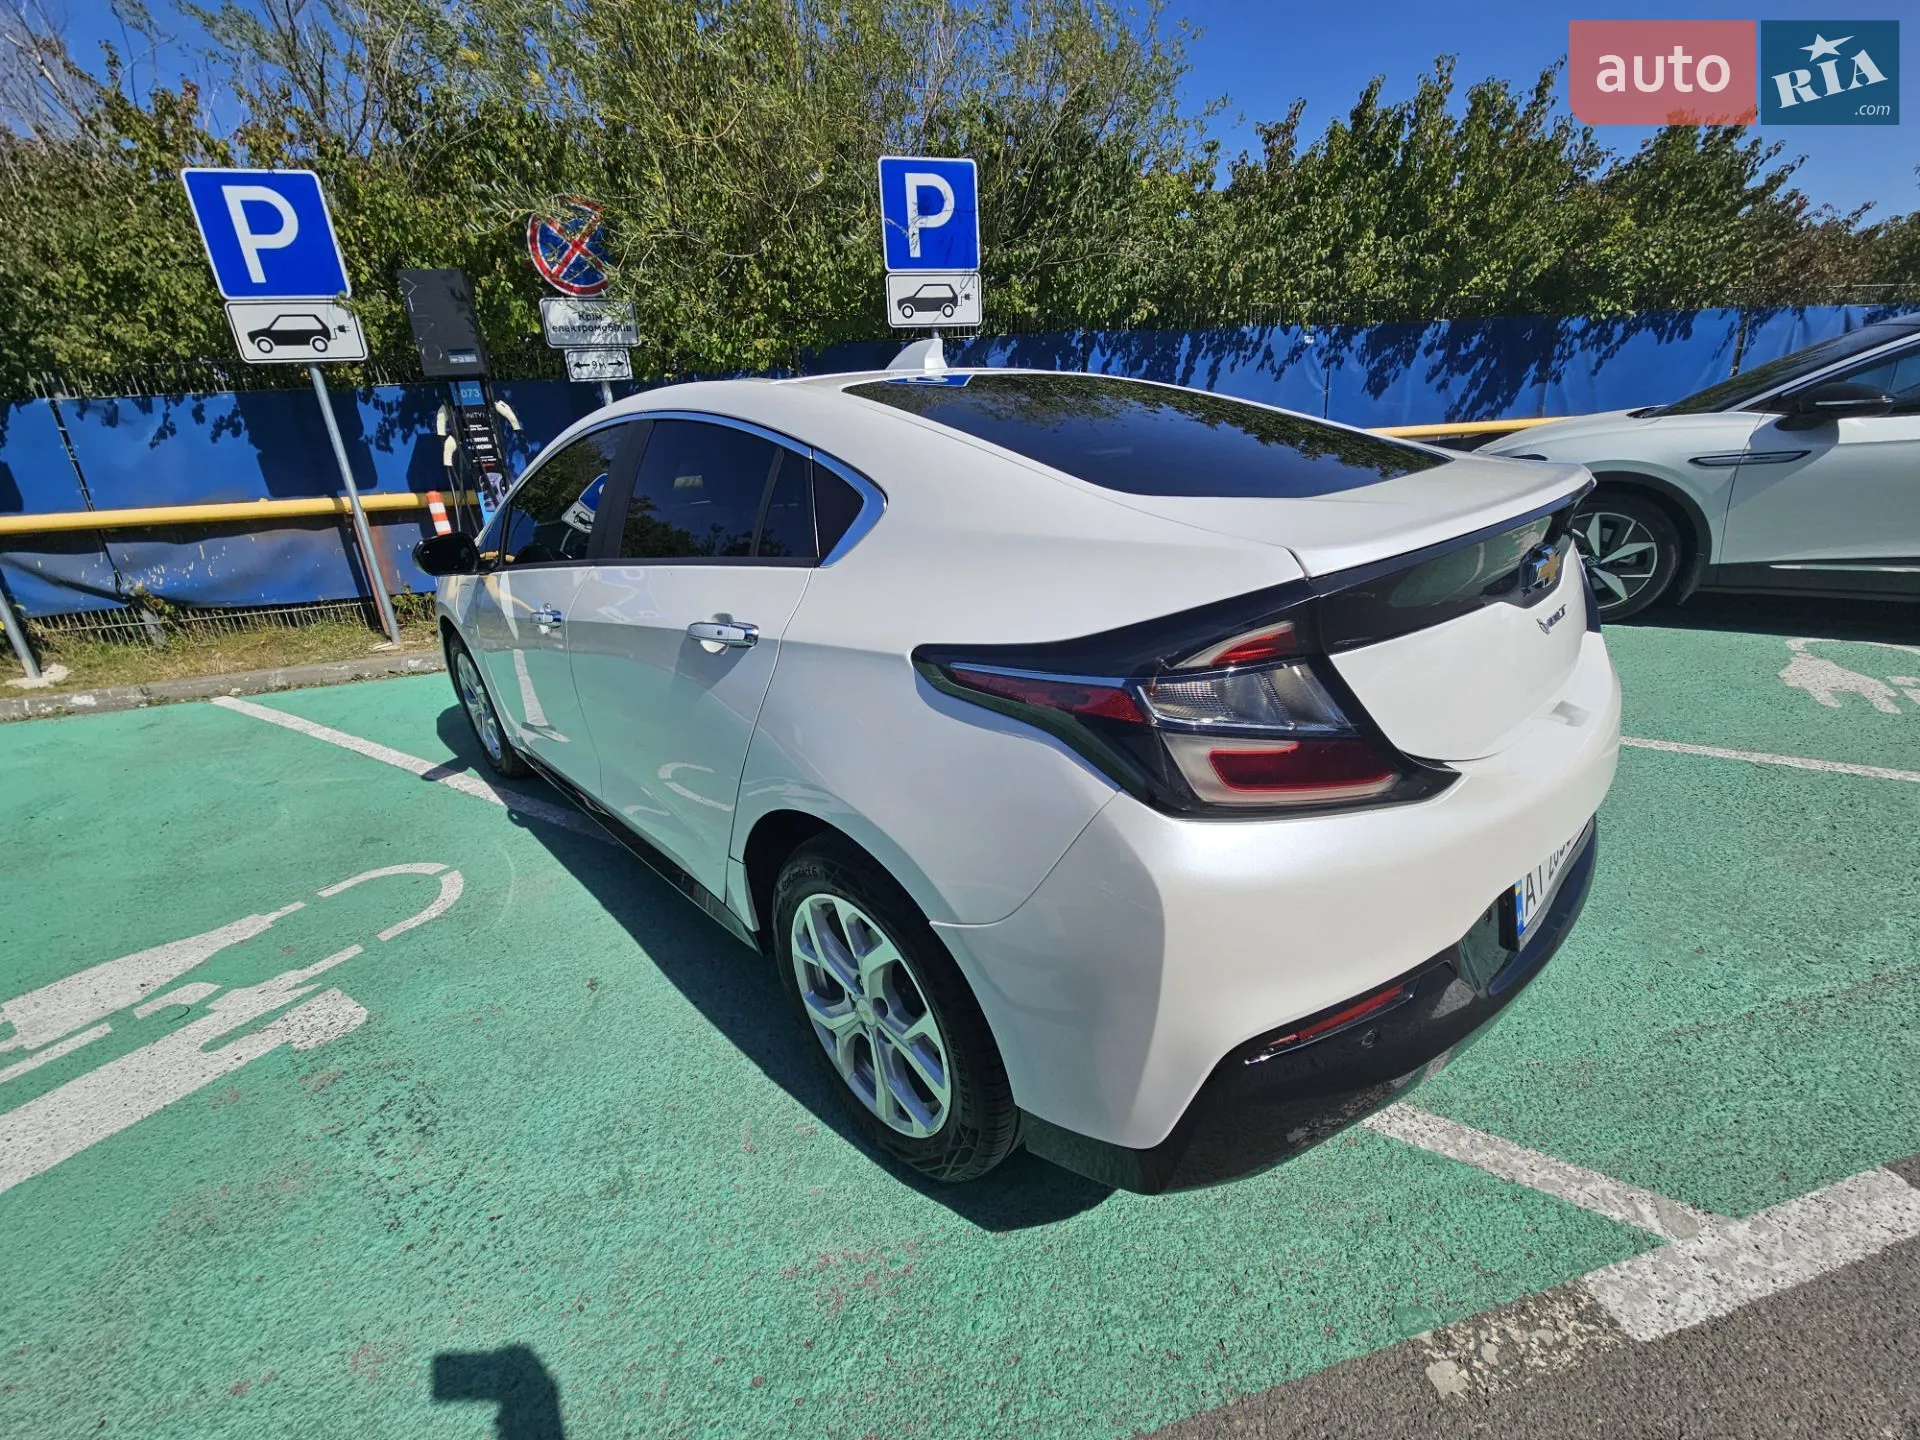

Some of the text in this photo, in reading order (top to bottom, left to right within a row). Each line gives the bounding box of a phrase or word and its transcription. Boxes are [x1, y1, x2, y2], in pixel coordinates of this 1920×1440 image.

[221, 185, 299, 284] P
[904, 173, 955, 258] P
[552, 322, 632, 335] електромобілів
[578, 311, 603, 322] Крім
